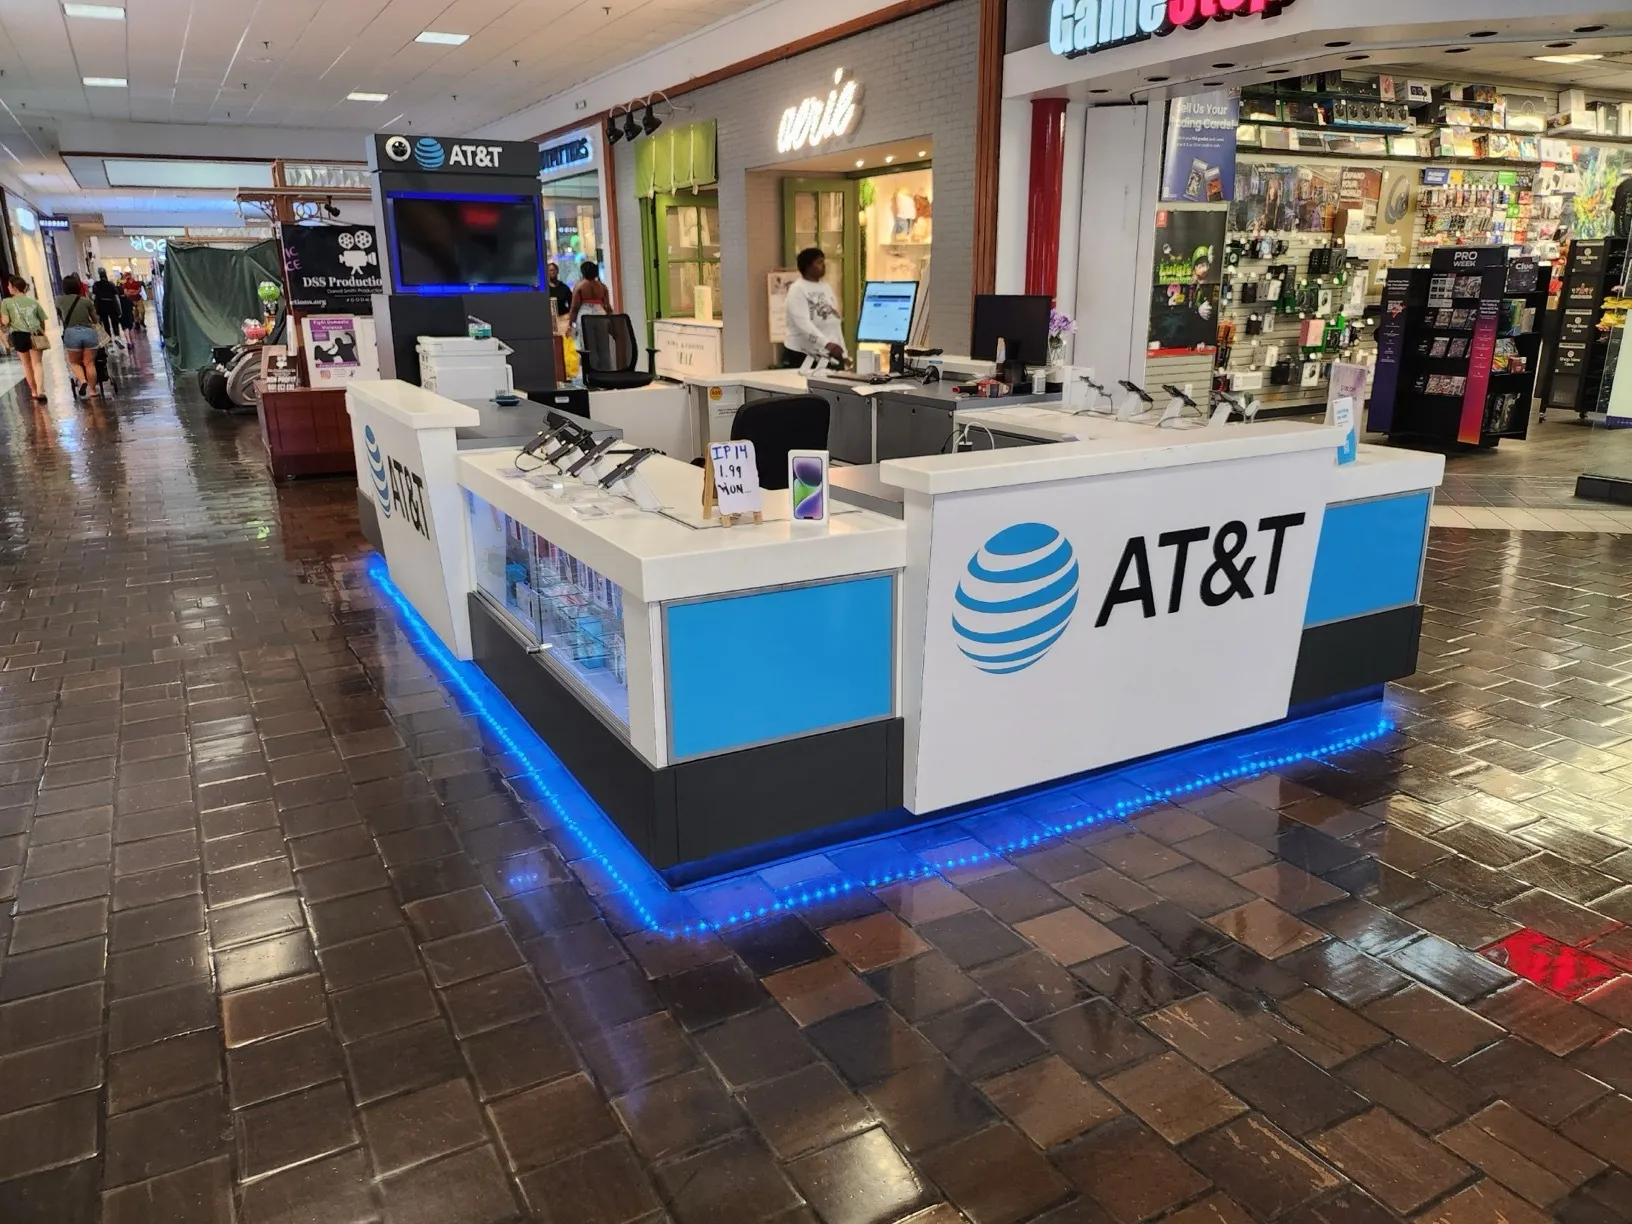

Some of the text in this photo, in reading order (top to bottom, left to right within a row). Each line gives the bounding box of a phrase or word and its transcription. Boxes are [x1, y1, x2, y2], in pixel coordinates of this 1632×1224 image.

[1050, 0, 1268, 55] Game
[1193, 104, 1205, 114] Us
[1207, 104, 1228, 115] Your
[1203, 119, 1234, 130] Cards!
[449, 144, 503, 168] AT&T
[1454, 251, 1478, 260] PRO
[1515, 262, 1534, 270] Clue
[303, 275, 383, 288] DSS Productio
[712, 444, 748, 461] IP 14
[719, 465, 742, 478] 1.99
[387, 455, 430, 541] AT&T
[1094, 511, 1306, 628] AT&T
